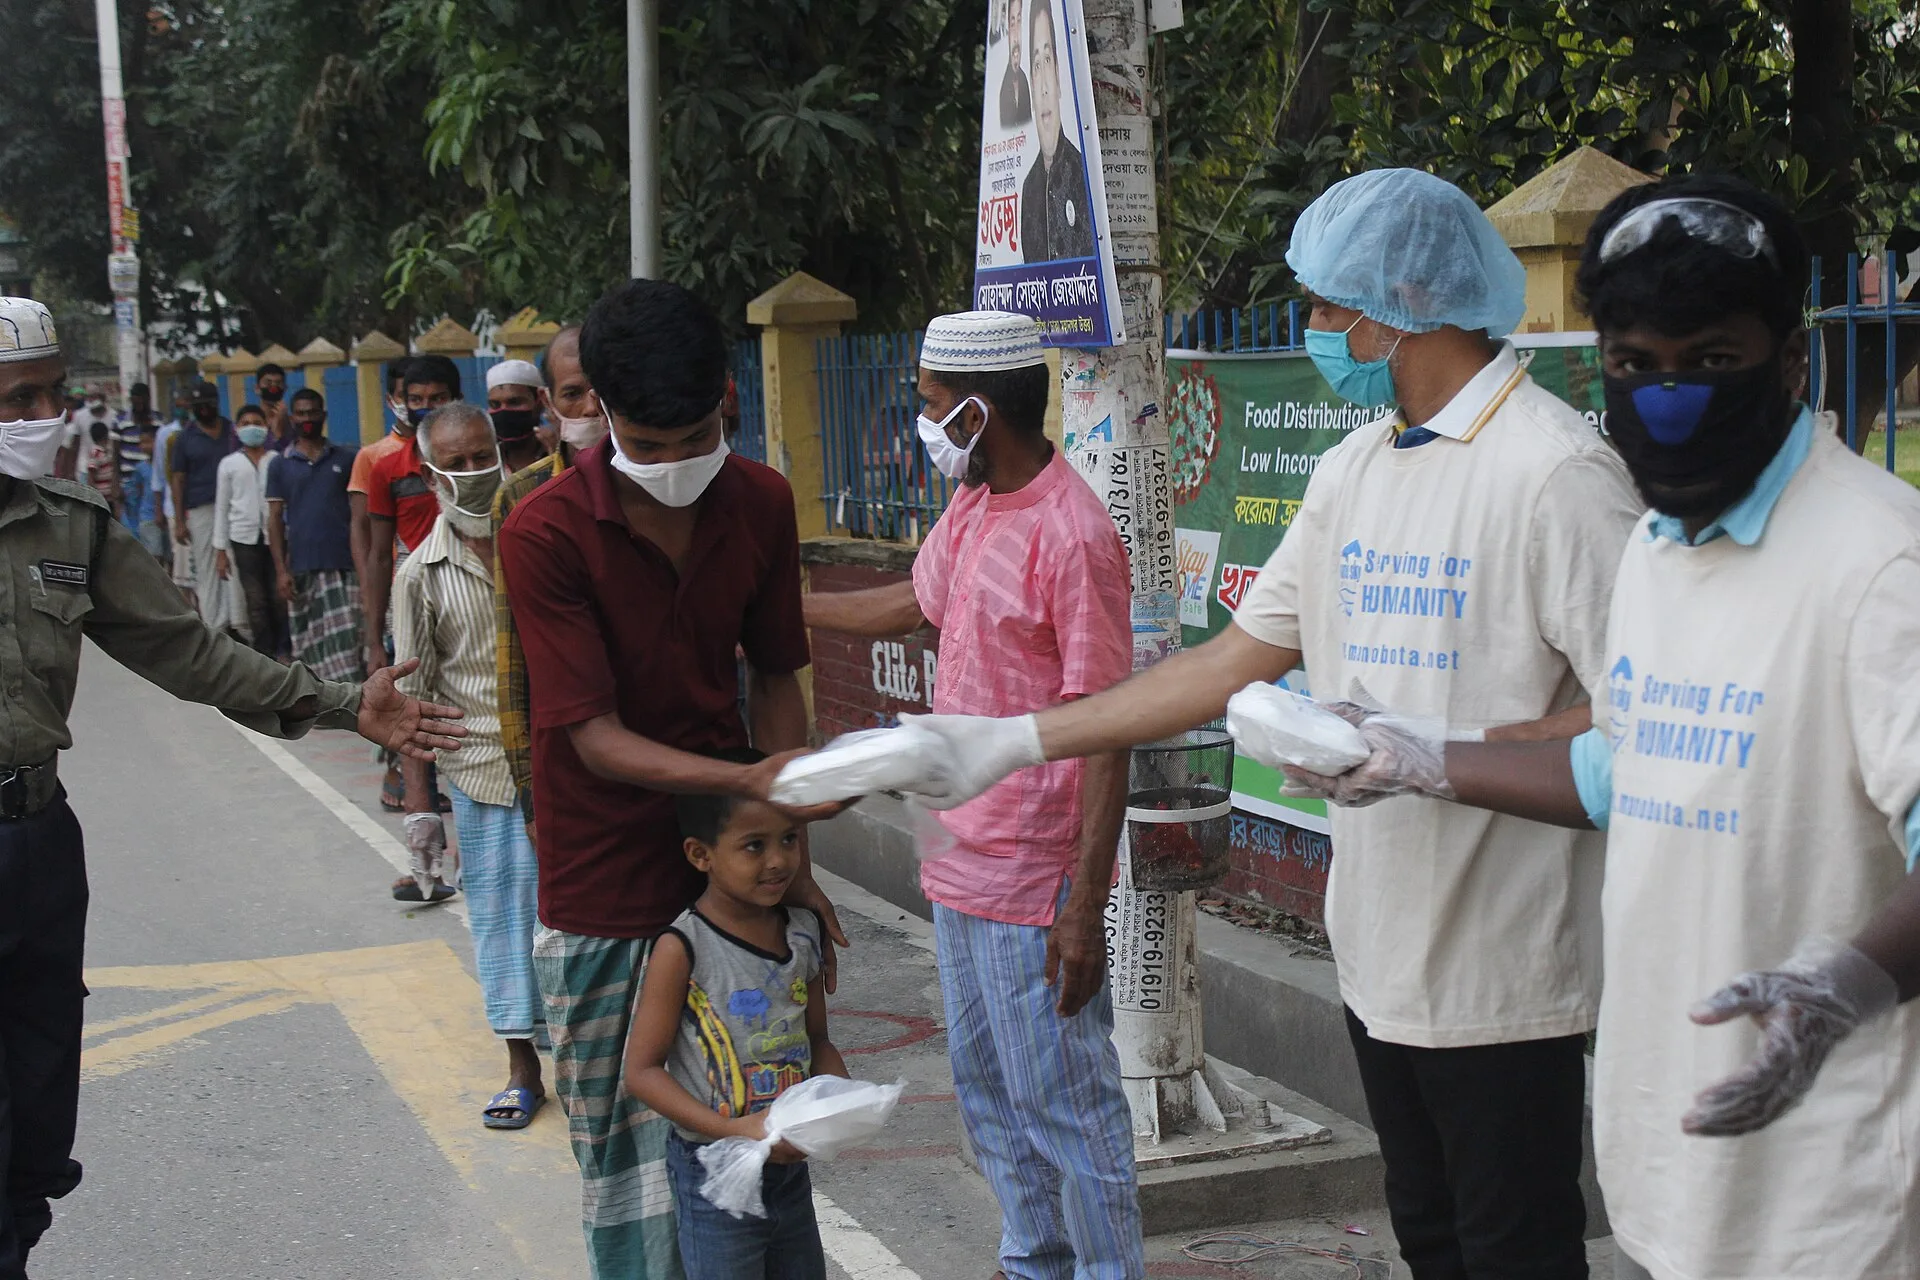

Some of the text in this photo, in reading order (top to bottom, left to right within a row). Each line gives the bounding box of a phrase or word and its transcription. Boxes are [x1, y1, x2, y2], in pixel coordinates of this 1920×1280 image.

[1016, 276, 1049, 312] সোহাগ
[1245, 401, 1281, 429] Food
[1284, 402, 1369, 430] Distribution
[1240, 446, 1272, 473] Low
[1152, 449, 1173, 589] 01919-923347
[1234, 496, 1279, 525] করোনা
[1176, 539, 1209, 584] Stay
[871, 640, 921, 702] Elite
[1642, 674, 1712, 716] Serving
[1719, 682, 1765, 717] For
[1635, 718, 1756, 769] HUMANITY
